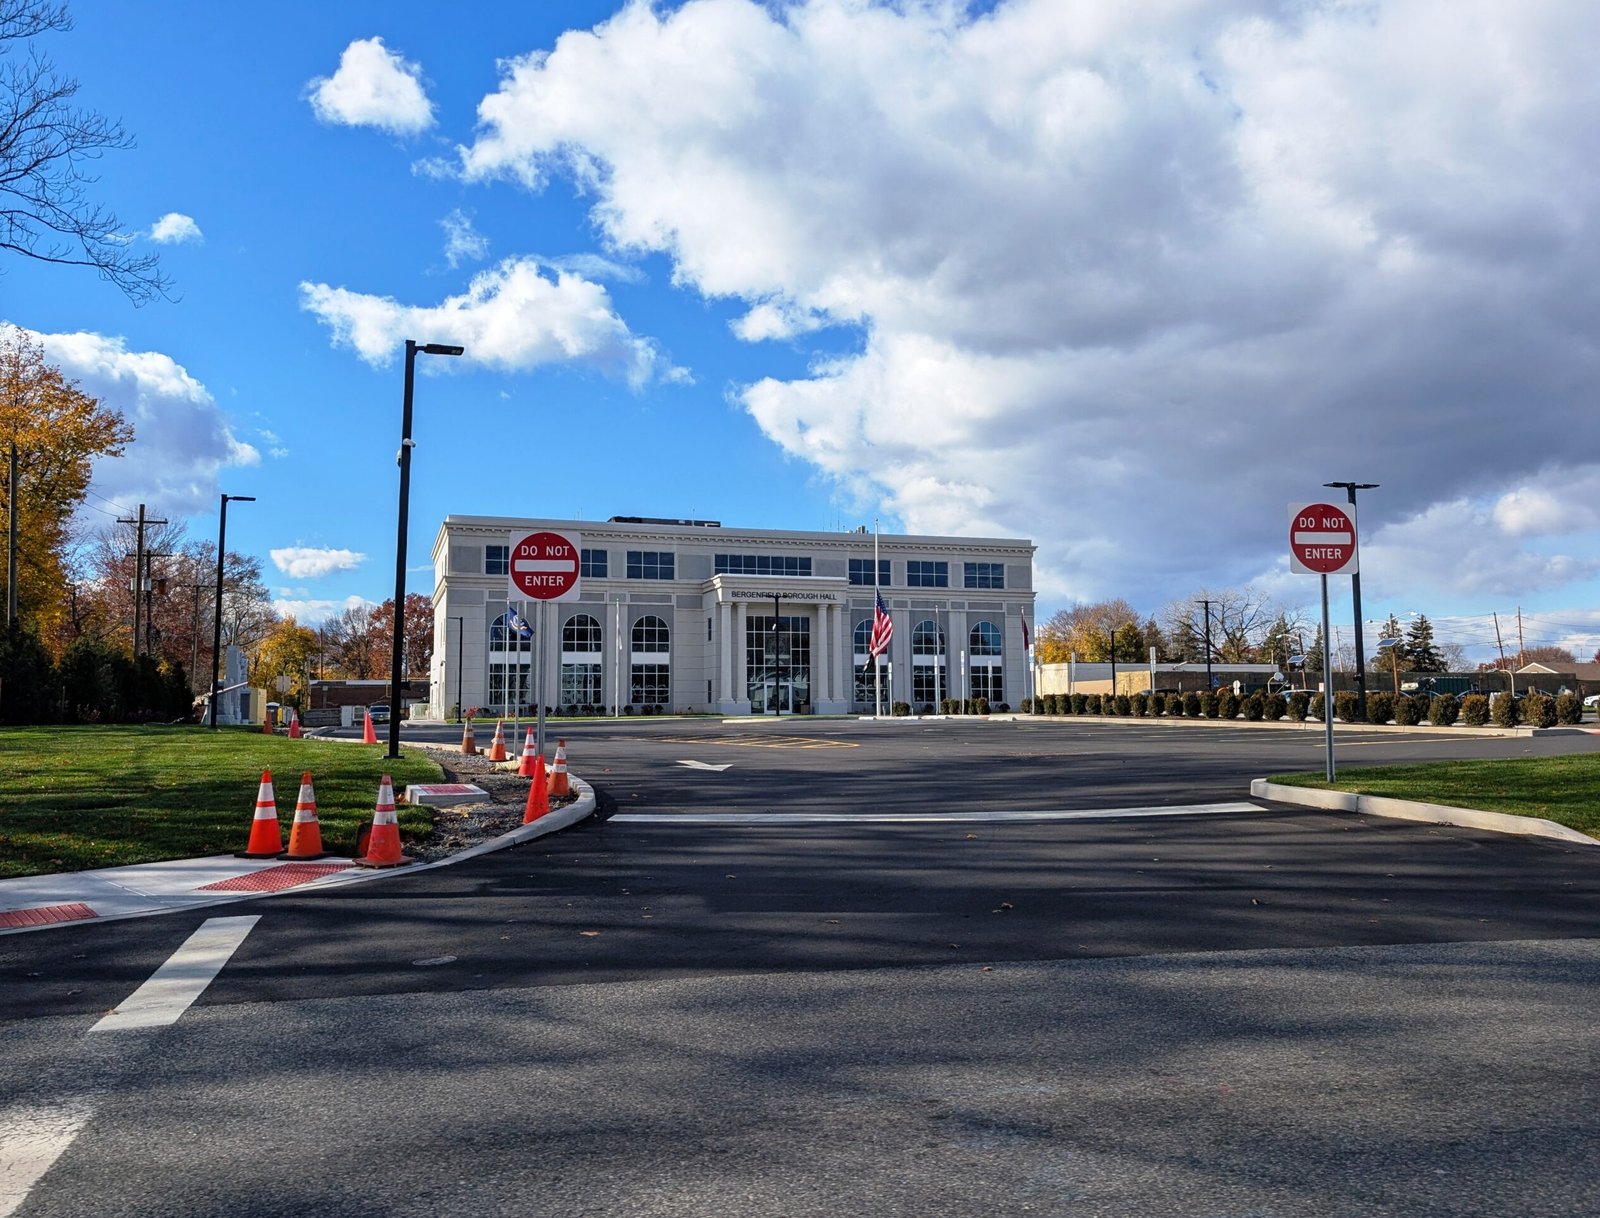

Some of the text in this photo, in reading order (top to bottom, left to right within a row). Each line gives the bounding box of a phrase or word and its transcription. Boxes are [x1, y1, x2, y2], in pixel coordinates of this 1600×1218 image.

[1299, 517, 1345, 529] DO NOT
[521, 545, 570, 557] DO NOT
[1305, 548, 1342, 559] ENTER
[525, 575, 564, 586] ENTER
[820, 593, 837, 601] HALL
